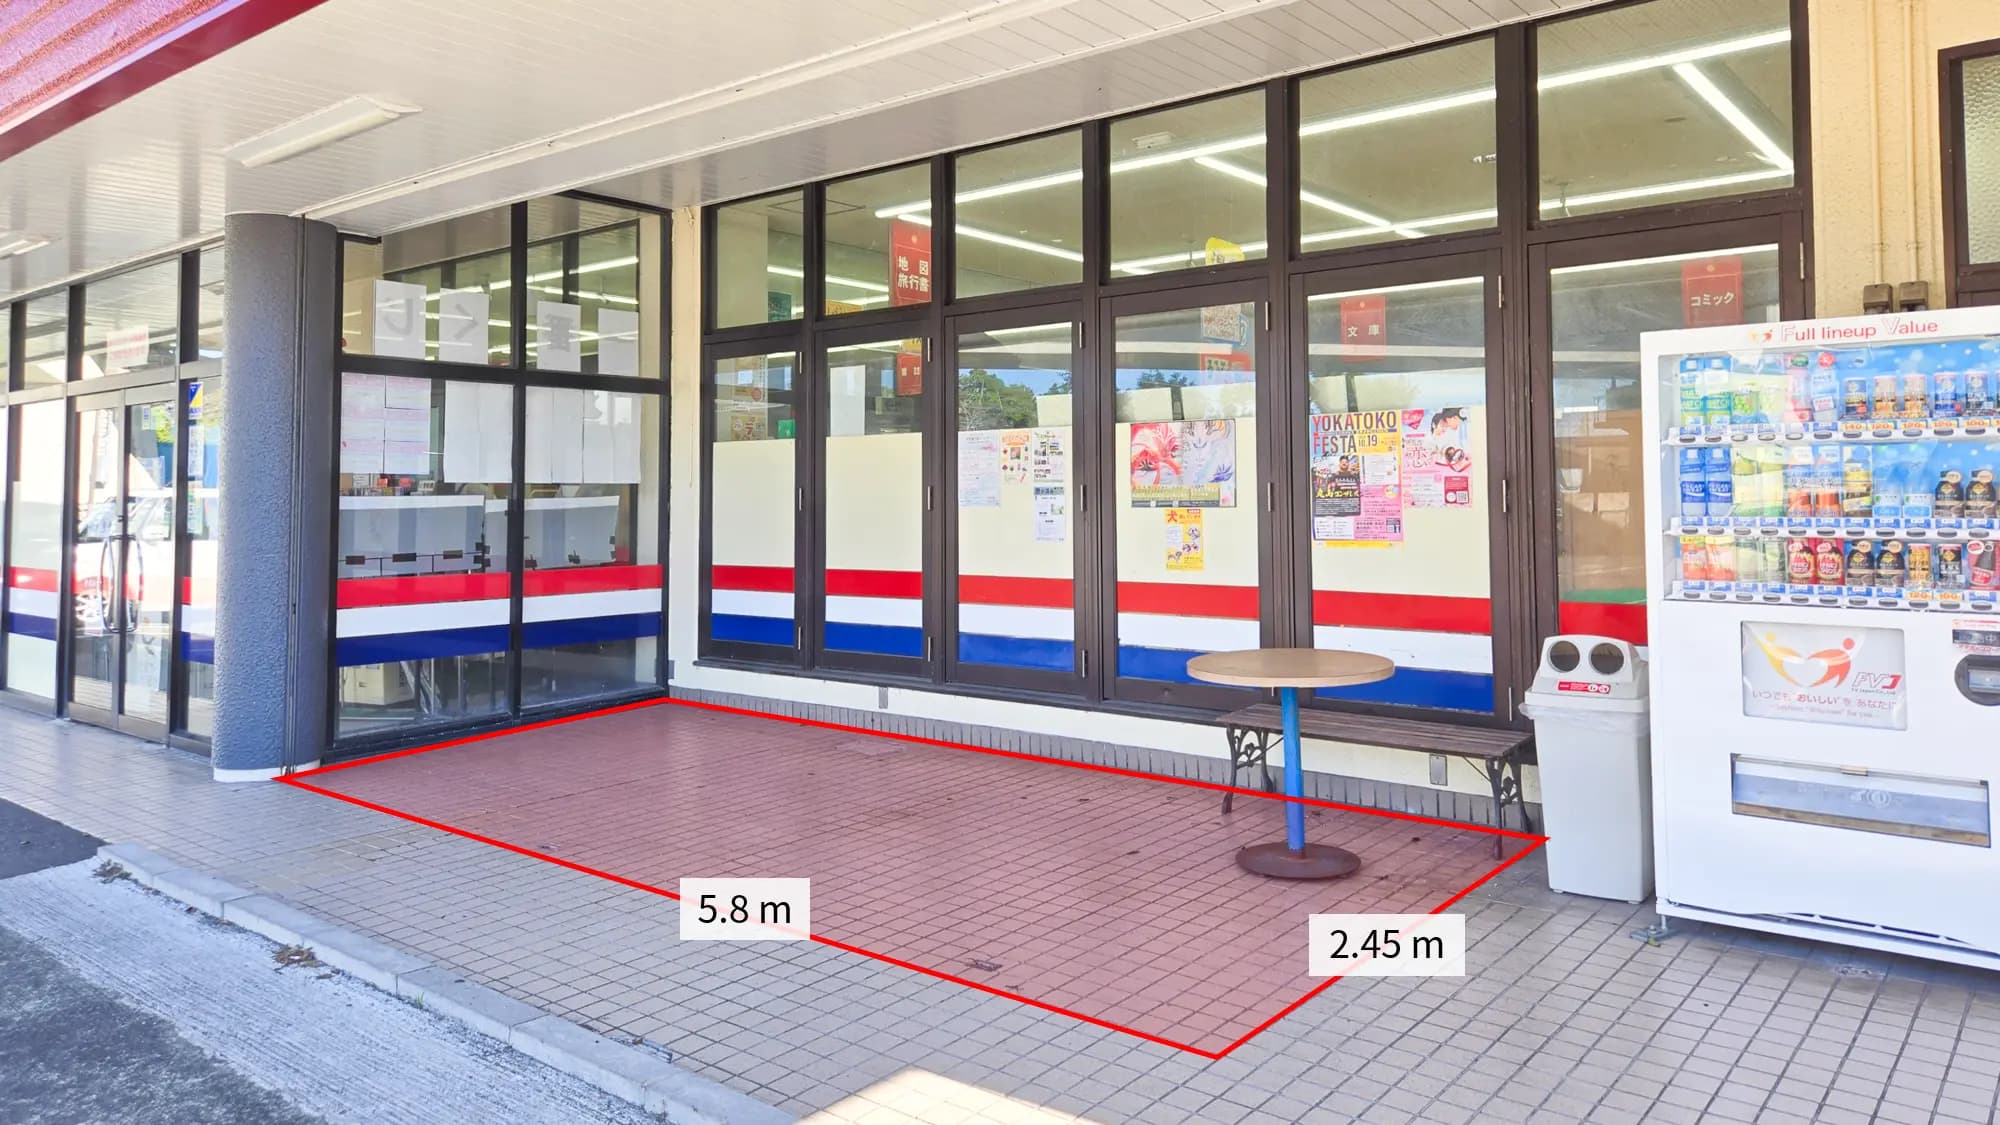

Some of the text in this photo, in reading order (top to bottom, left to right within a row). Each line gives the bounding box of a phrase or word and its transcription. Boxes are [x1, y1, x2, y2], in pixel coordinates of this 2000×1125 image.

[1690, 291, 1735, 307] コミック
[1347, 325, 1380, 338] 文庫
[1780, 316, 1938, 342] Full lineup Value
[1312, 411, 1397, 432] YOKATOKO
[1313, 433, 1357, 454] FESTA
